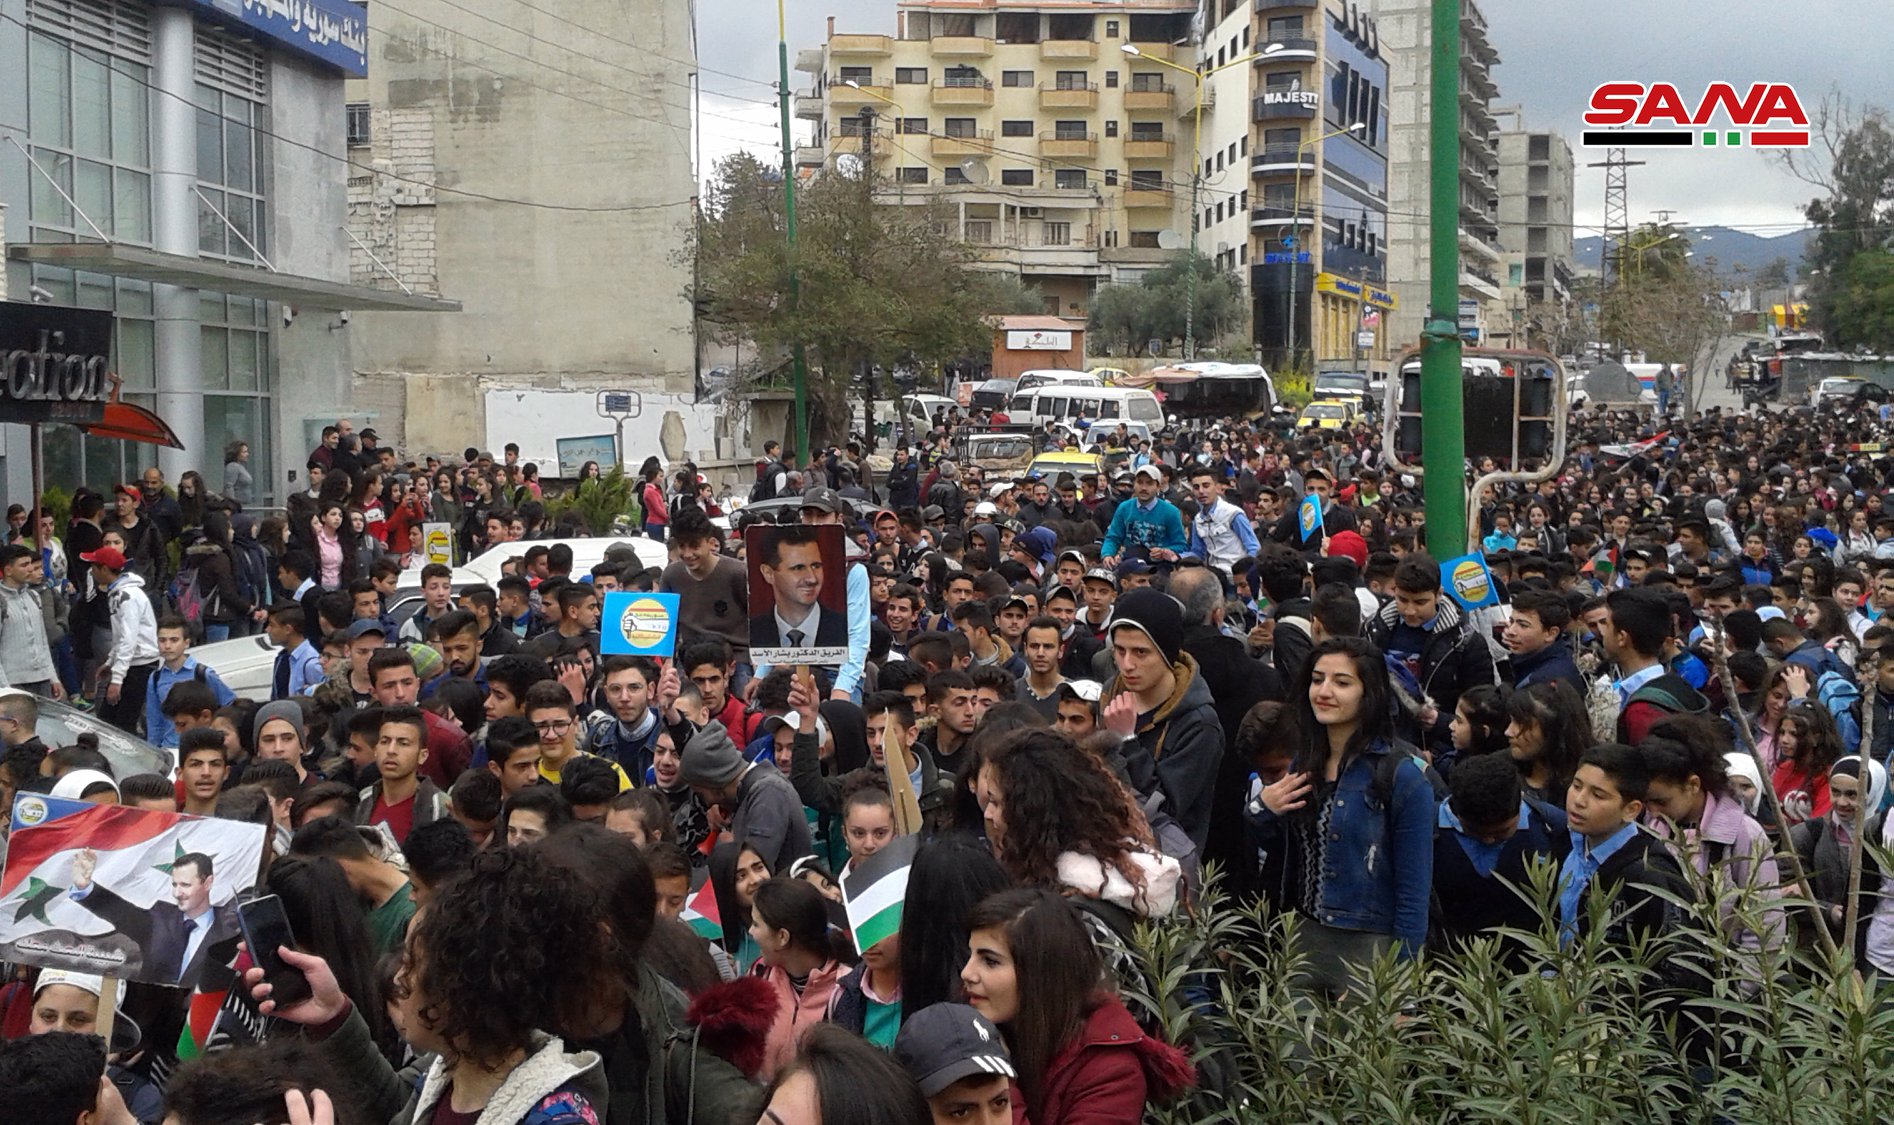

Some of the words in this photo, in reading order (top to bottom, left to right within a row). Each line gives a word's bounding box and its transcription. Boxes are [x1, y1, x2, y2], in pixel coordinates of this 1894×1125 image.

[772, 649, 790, 659] بشار
[789, 648, 820, 659] الدكتور
[819, 648, 845, 658] الفريق
